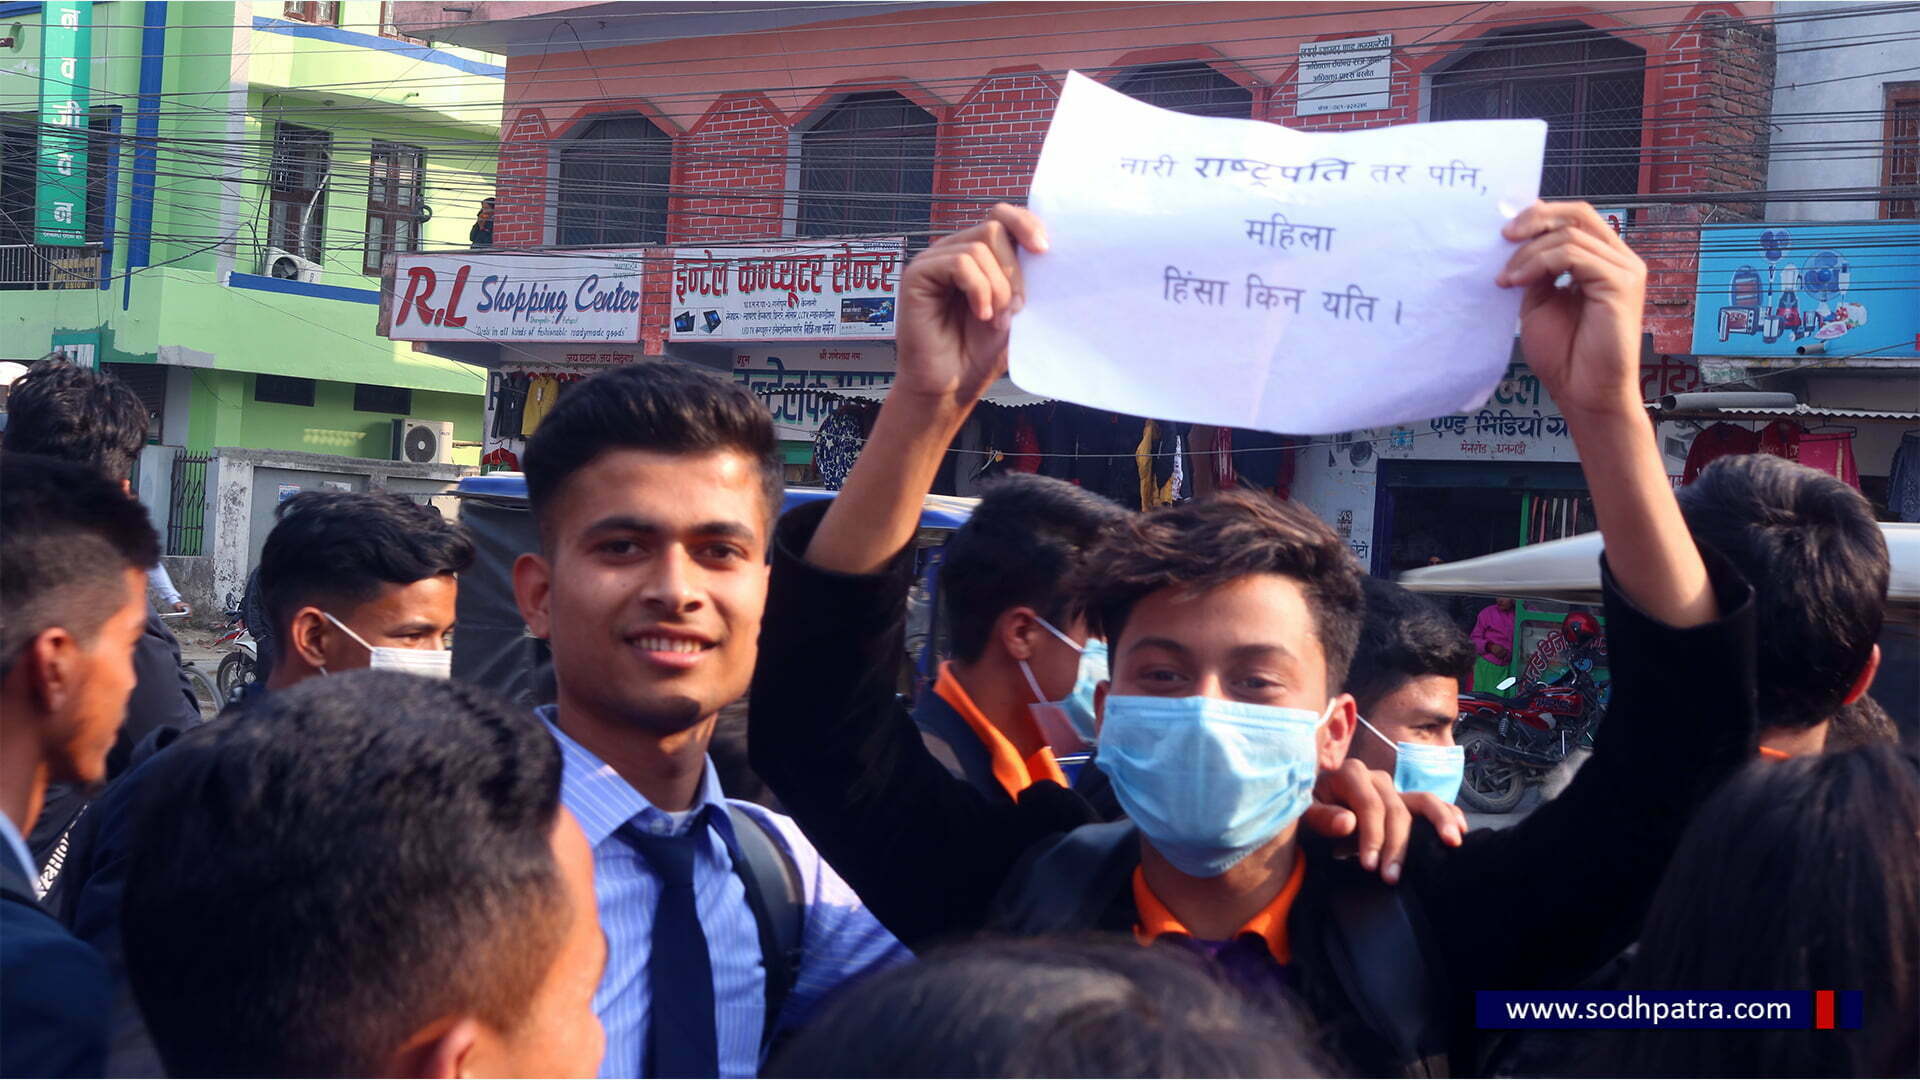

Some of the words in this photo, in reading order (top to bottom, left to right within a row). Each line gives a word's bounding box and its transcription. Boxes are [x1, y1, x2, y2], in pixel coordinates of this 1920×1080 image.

[1120, 154, 1178, 177] नारी
[1194, 156, 1355, 188] राष्ट्रपति
[1370, 163, 1412, 184] तर
[1428, 159, 1488, 196] पनि,
[1245, 212, 1336, 252] महिला
[396, 264, 471, 329] R.L
[476, 274, 569, 324] Shopping
[574, 273, 640, 314] Center
[1163, 265, 1229, 307] हिंसा
[1246, 273, 1307, 315] किन
[1321, 284, 1379, 323] यति
[500, 326, 509, 336] all
[1430, 415, 1469, 438] एण्ड
[1475, 409, 1543, 439] भिडियो
